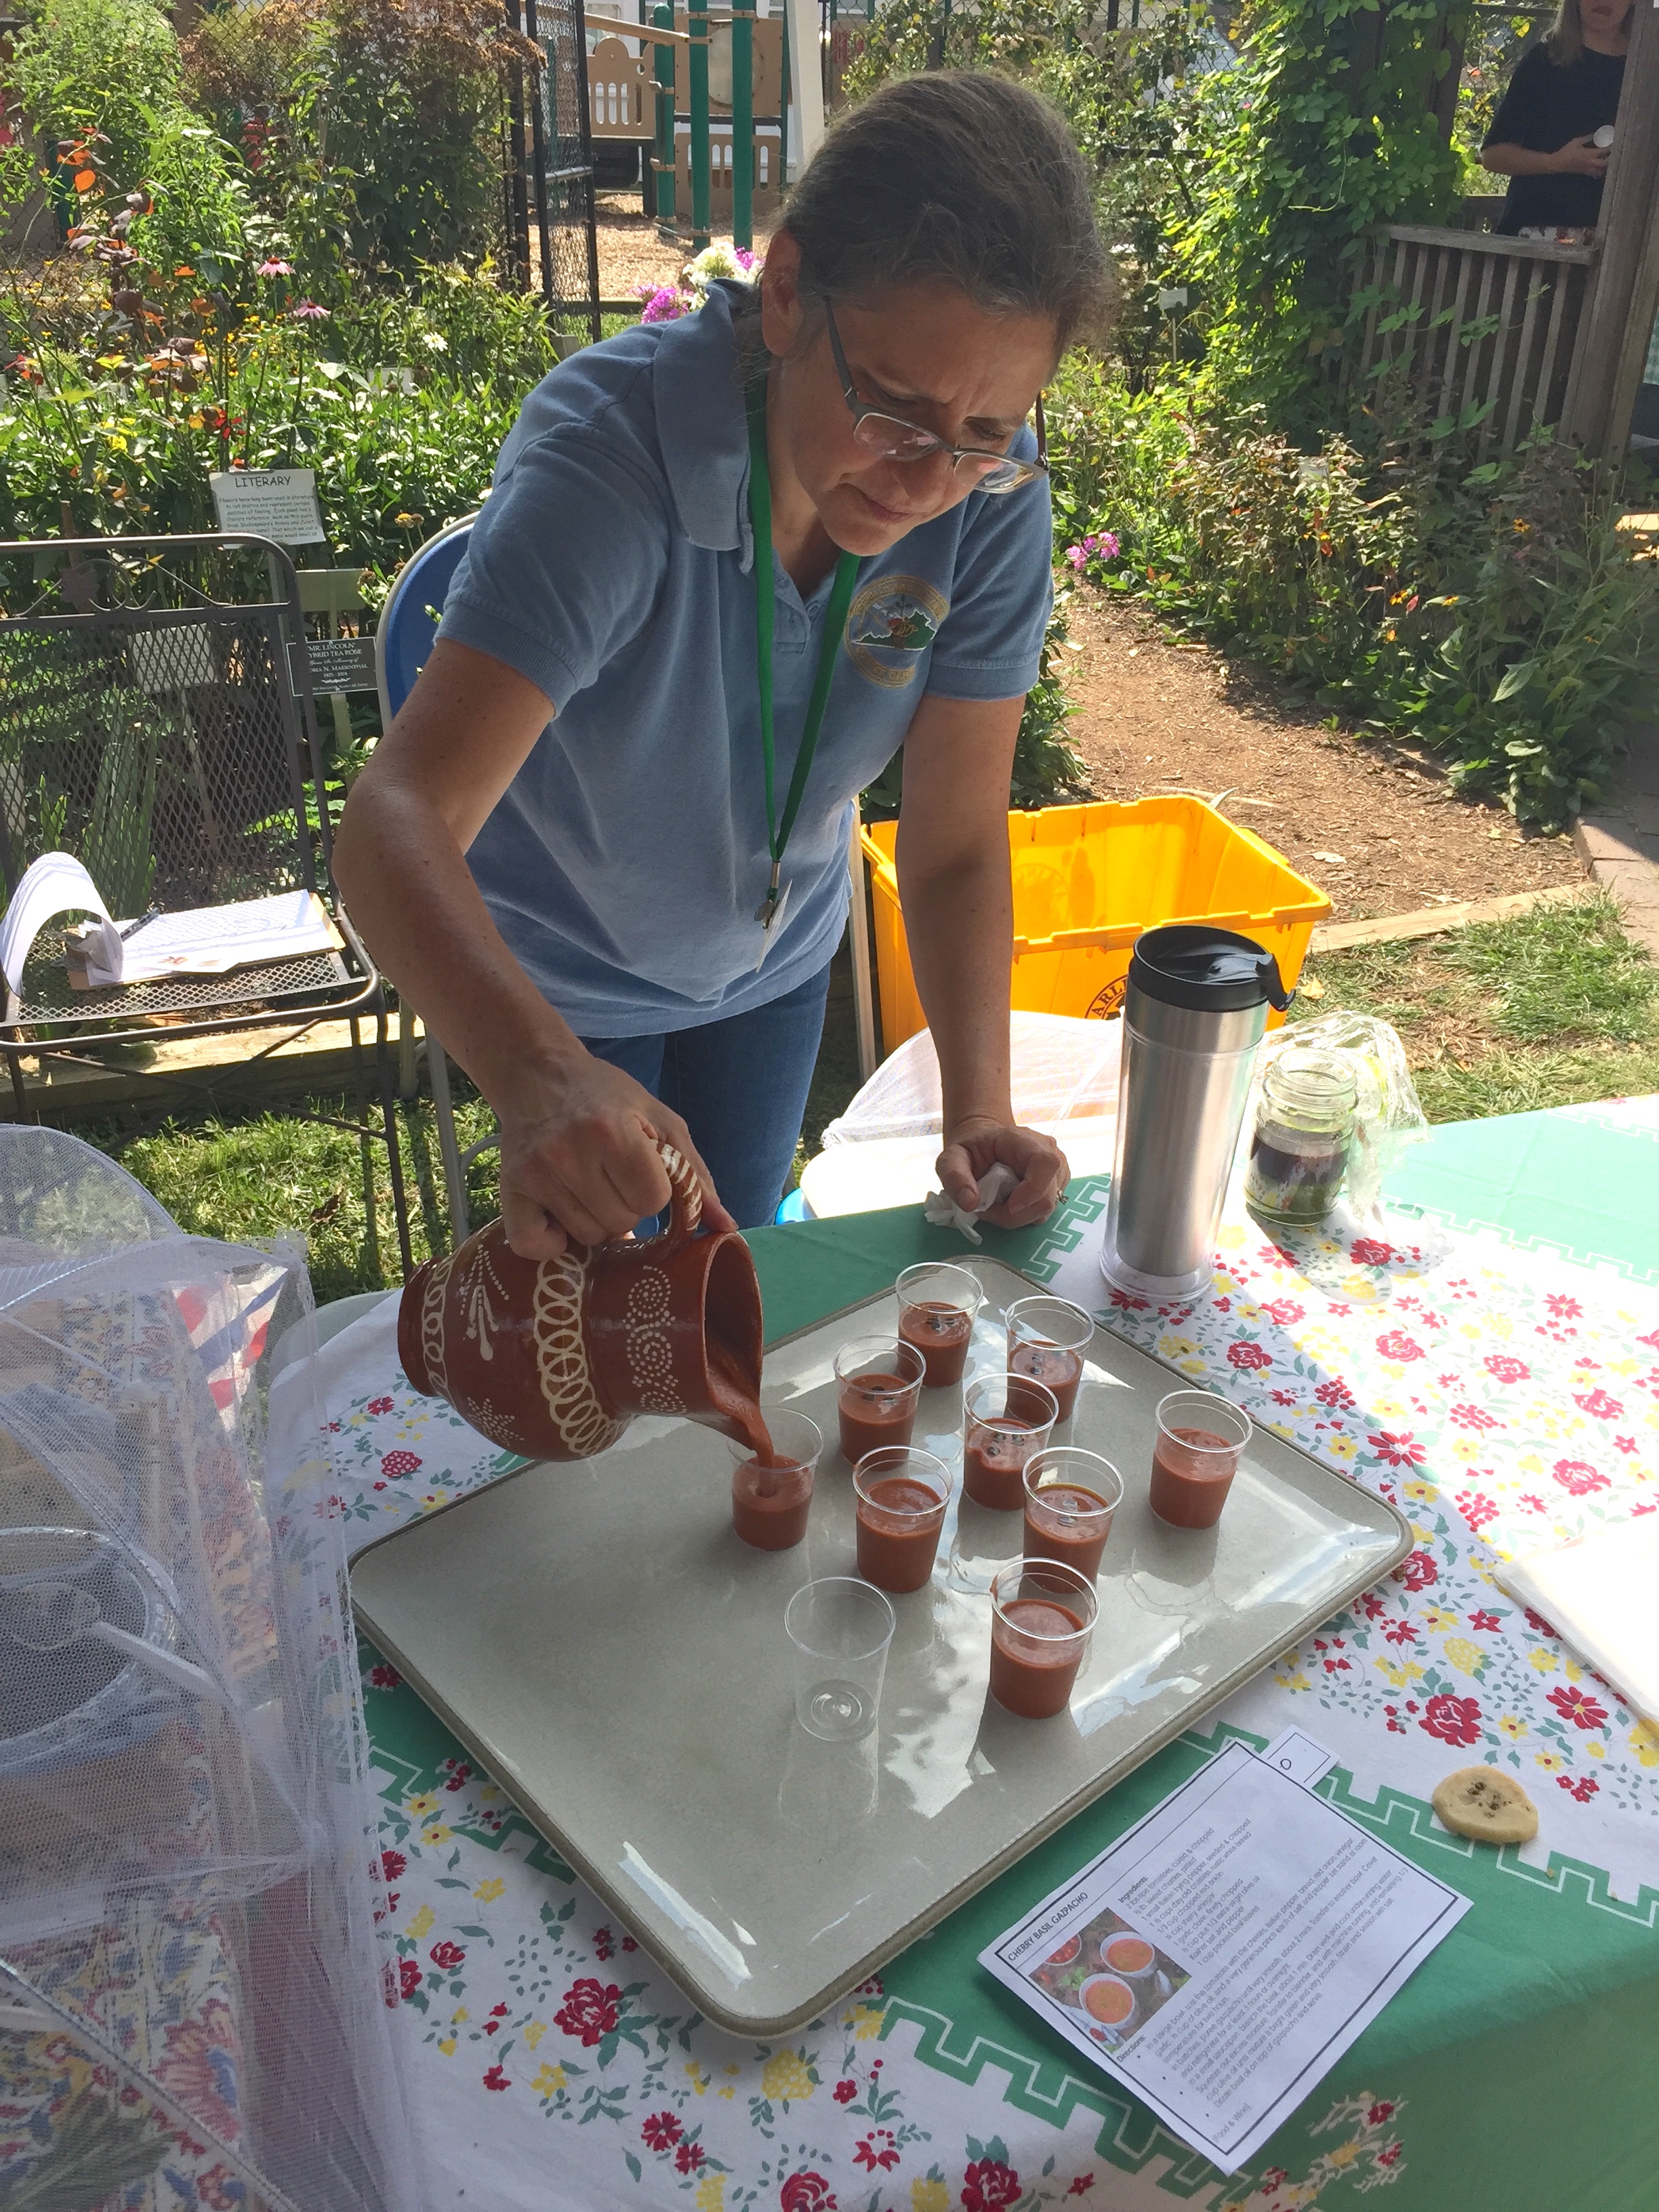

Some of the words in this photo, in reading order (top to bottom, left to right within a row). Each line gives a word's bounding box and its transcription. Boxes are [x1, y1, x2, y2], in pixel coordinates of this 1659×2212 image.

[235, 476, 291, 488] LITERARY
[1091, 979, 1127, 1017] ARLI
[1191, 1827, 1214, 1849] chopped
[1206, 1843, 1225, 1861] seeded
[1228, 1818, 1251, 1840] chopped
[1118, 1877, 1148, 1903] Ingredients:
[1220, 1878, 1243, 1902] chopped
[1159, 1906, 1173, 1919] cups
[1166, 1915, 1178, 1926] cup
[1199, 1883, 1210, 1894] red
[1008, 1936, 1034, 1961] CHERRY
[1032, 1922, 1053, 1939] BASIL
[1050, 1892, 1088, 1923] GAZPACHO
[1215, 1922, 1227, 1935] and
[1225, 1906, 1244, 1925] pepper
[1187, 1937, 1199, 1948] cup
[1202, 1951, 1214, 1963] cup
[1212, 1931, 1233, 1953] packed
[1116, 2034, 1146, 2062] Directions:
